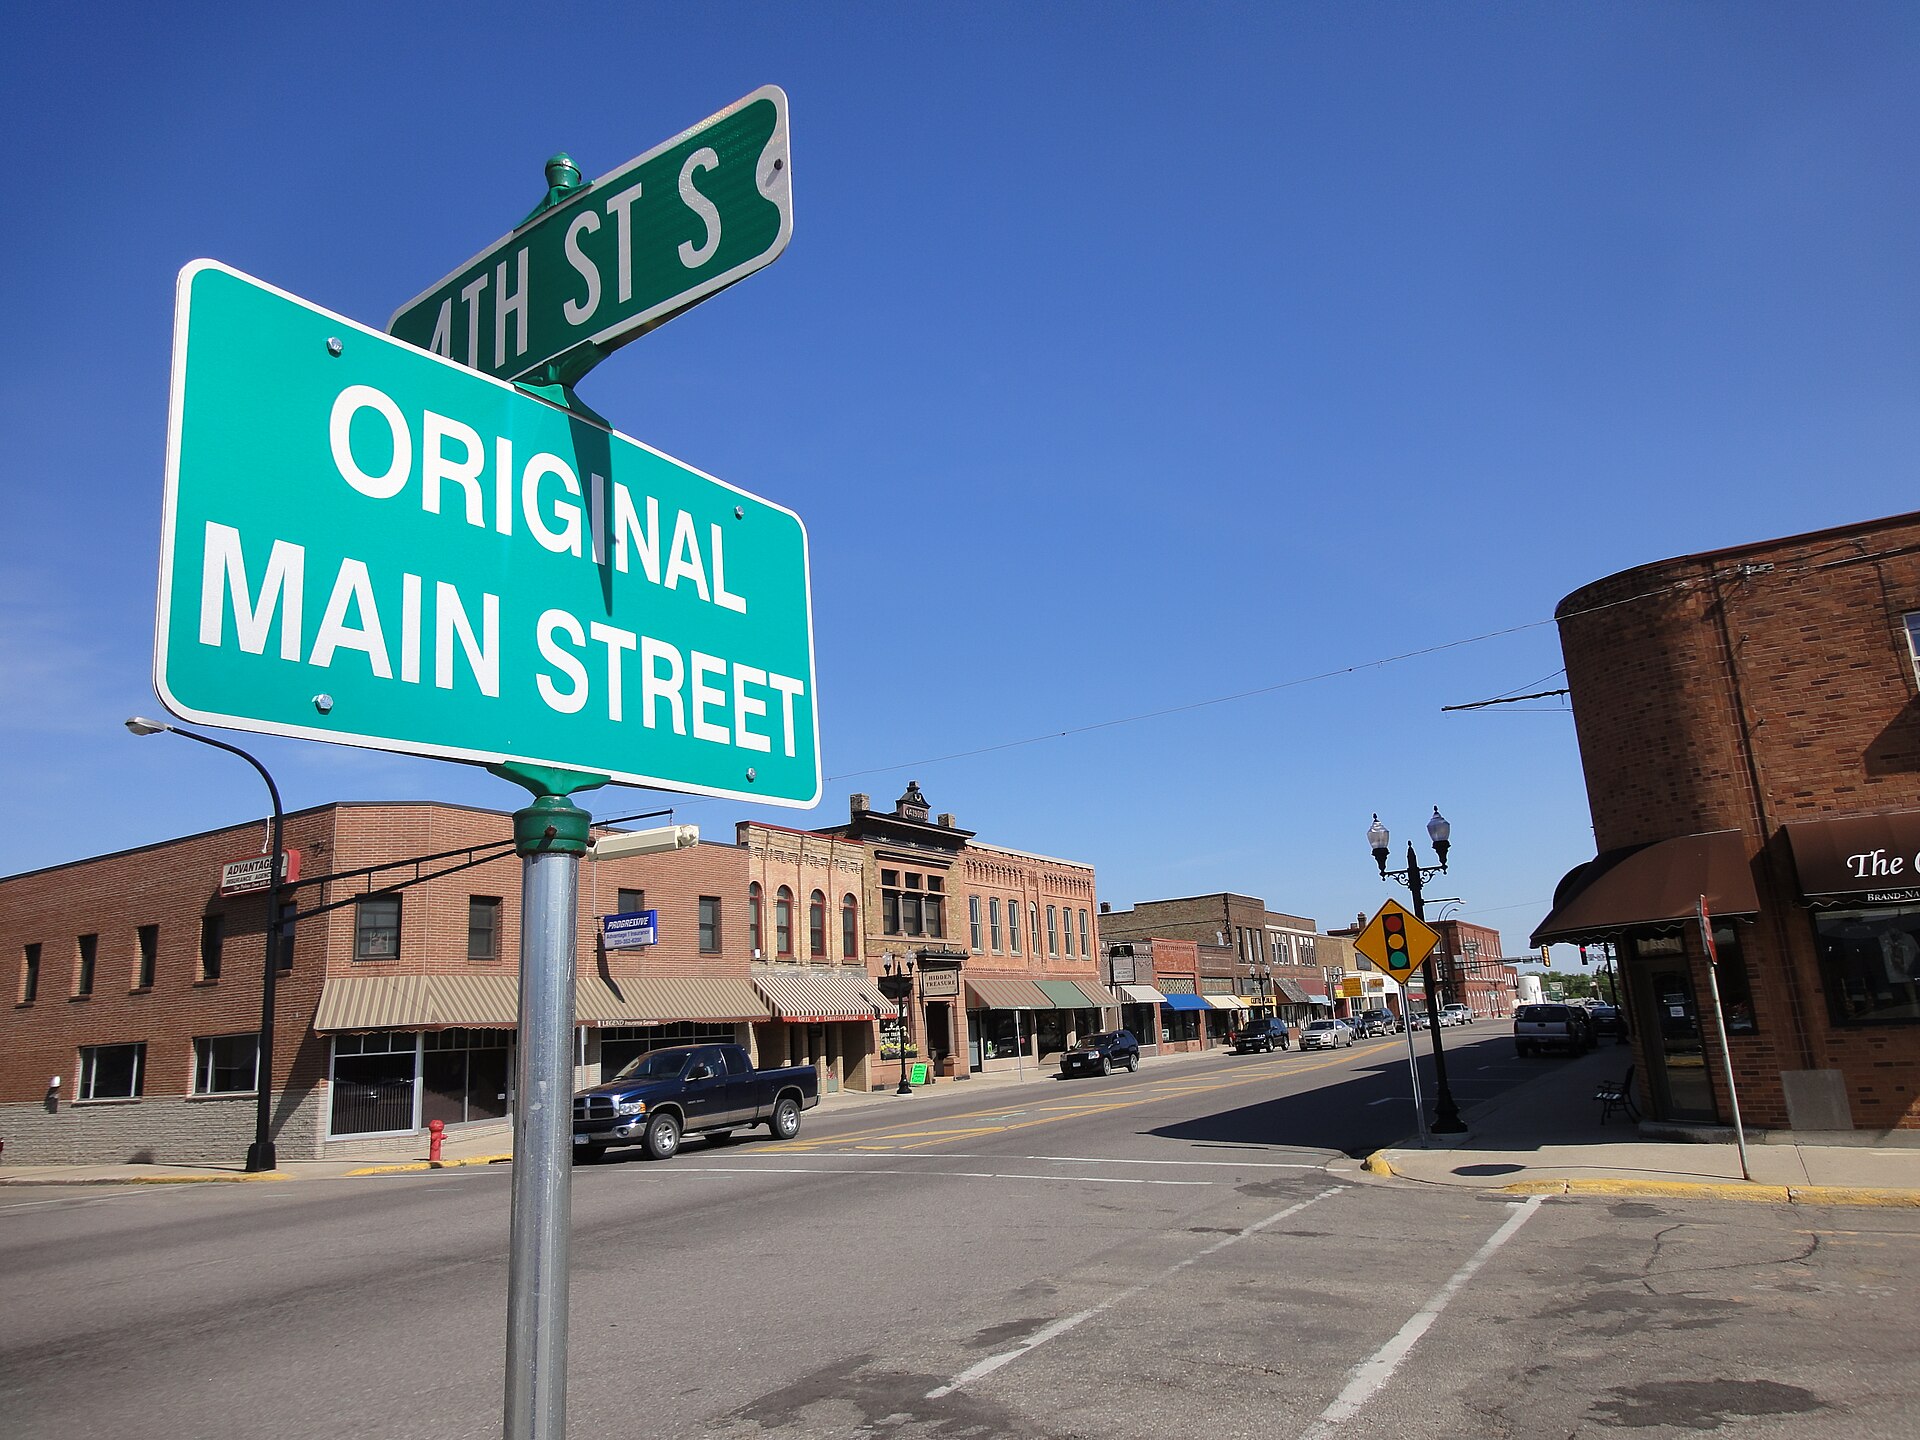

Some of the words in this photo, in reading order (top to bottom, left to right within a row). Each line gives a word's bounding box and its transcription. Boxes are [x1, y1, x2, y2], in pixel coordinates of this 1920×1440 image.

[428, 246, 529, 371] 4TH
[563, 182, 643, 326] ST
[678, 146, 722, 269] S
[328, 384, 748, 615] ORIGINAL
[199, 519, 501, 699] MAIN
[535, 608, 804, 758] STREET
[226, 875, 252, 885] INSURANCE
[254, 872, 272, 880] AGENC
[607, 916, 650, 930] PROGRESSIVE
[1846, 848, 1904, 878] The
